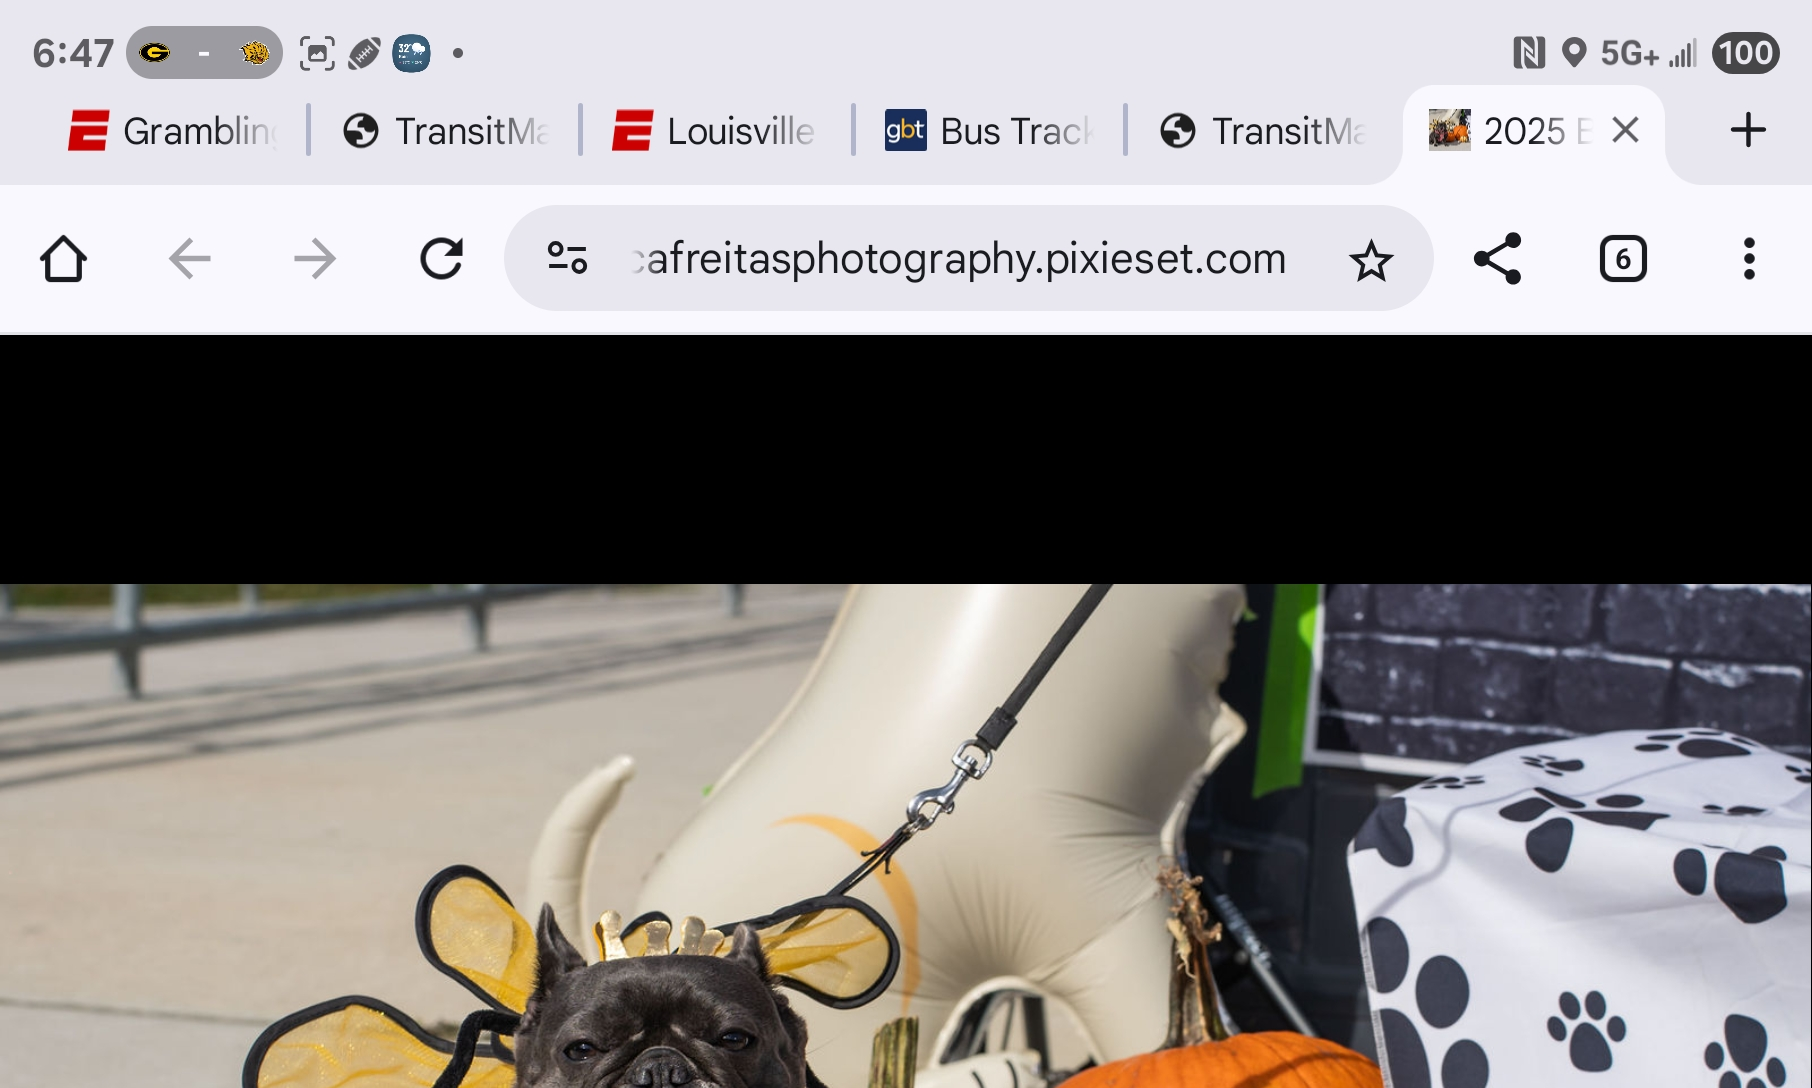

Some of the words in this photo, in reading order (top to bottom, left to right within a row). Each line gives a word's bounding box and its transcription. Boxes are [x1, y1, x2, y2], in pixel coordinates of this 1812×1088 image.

[33, 38, 114, 68] 6:47
[1601, 39, 1660, 66] 5G+
[1718, 40, 1774, 65] 100
[669, 115, 815, 145] Louisville
[887, 117, 925, 143] gbt
[943, 117, 1000, 145] Bus
[1485, 117, 1565, 145] 2025
[1615, 247, 1632, 271] 6
